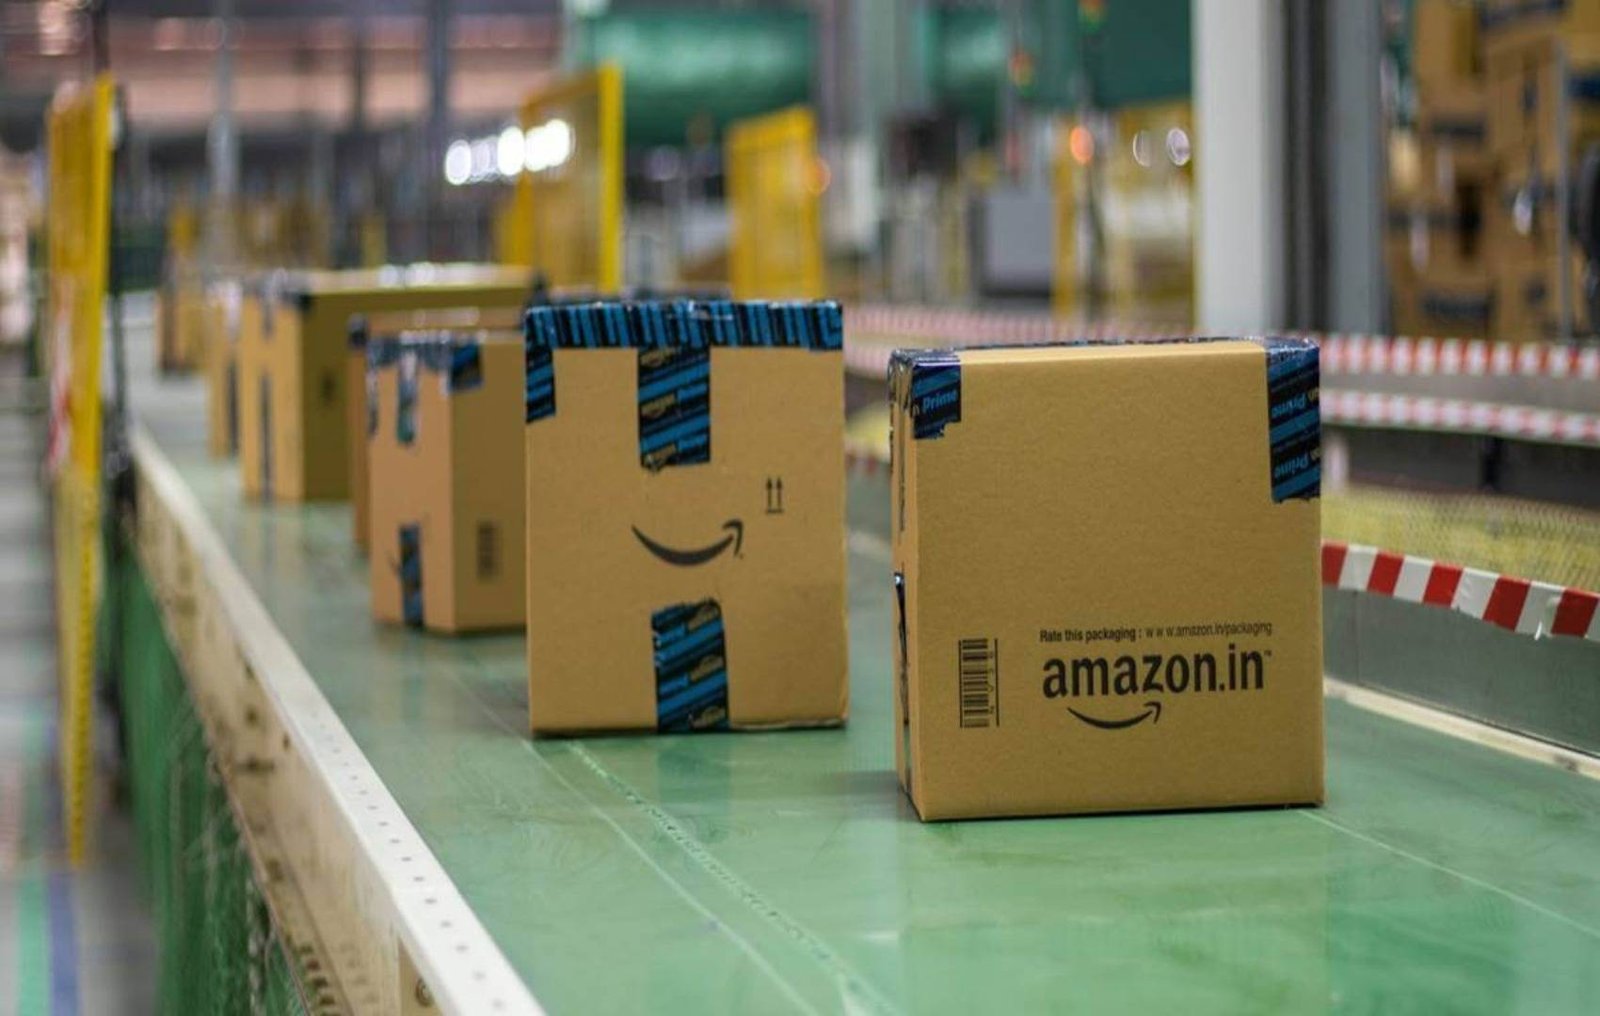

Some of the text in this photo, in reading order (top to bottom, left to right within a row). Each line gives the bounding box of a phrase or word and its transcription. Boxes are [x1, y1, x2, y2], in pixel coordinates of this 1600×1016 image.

[1039, 628, 1062, 642] Rate
[1064, 629, 1083, 642] this
[1085, 627, 1136, 644] packaging
